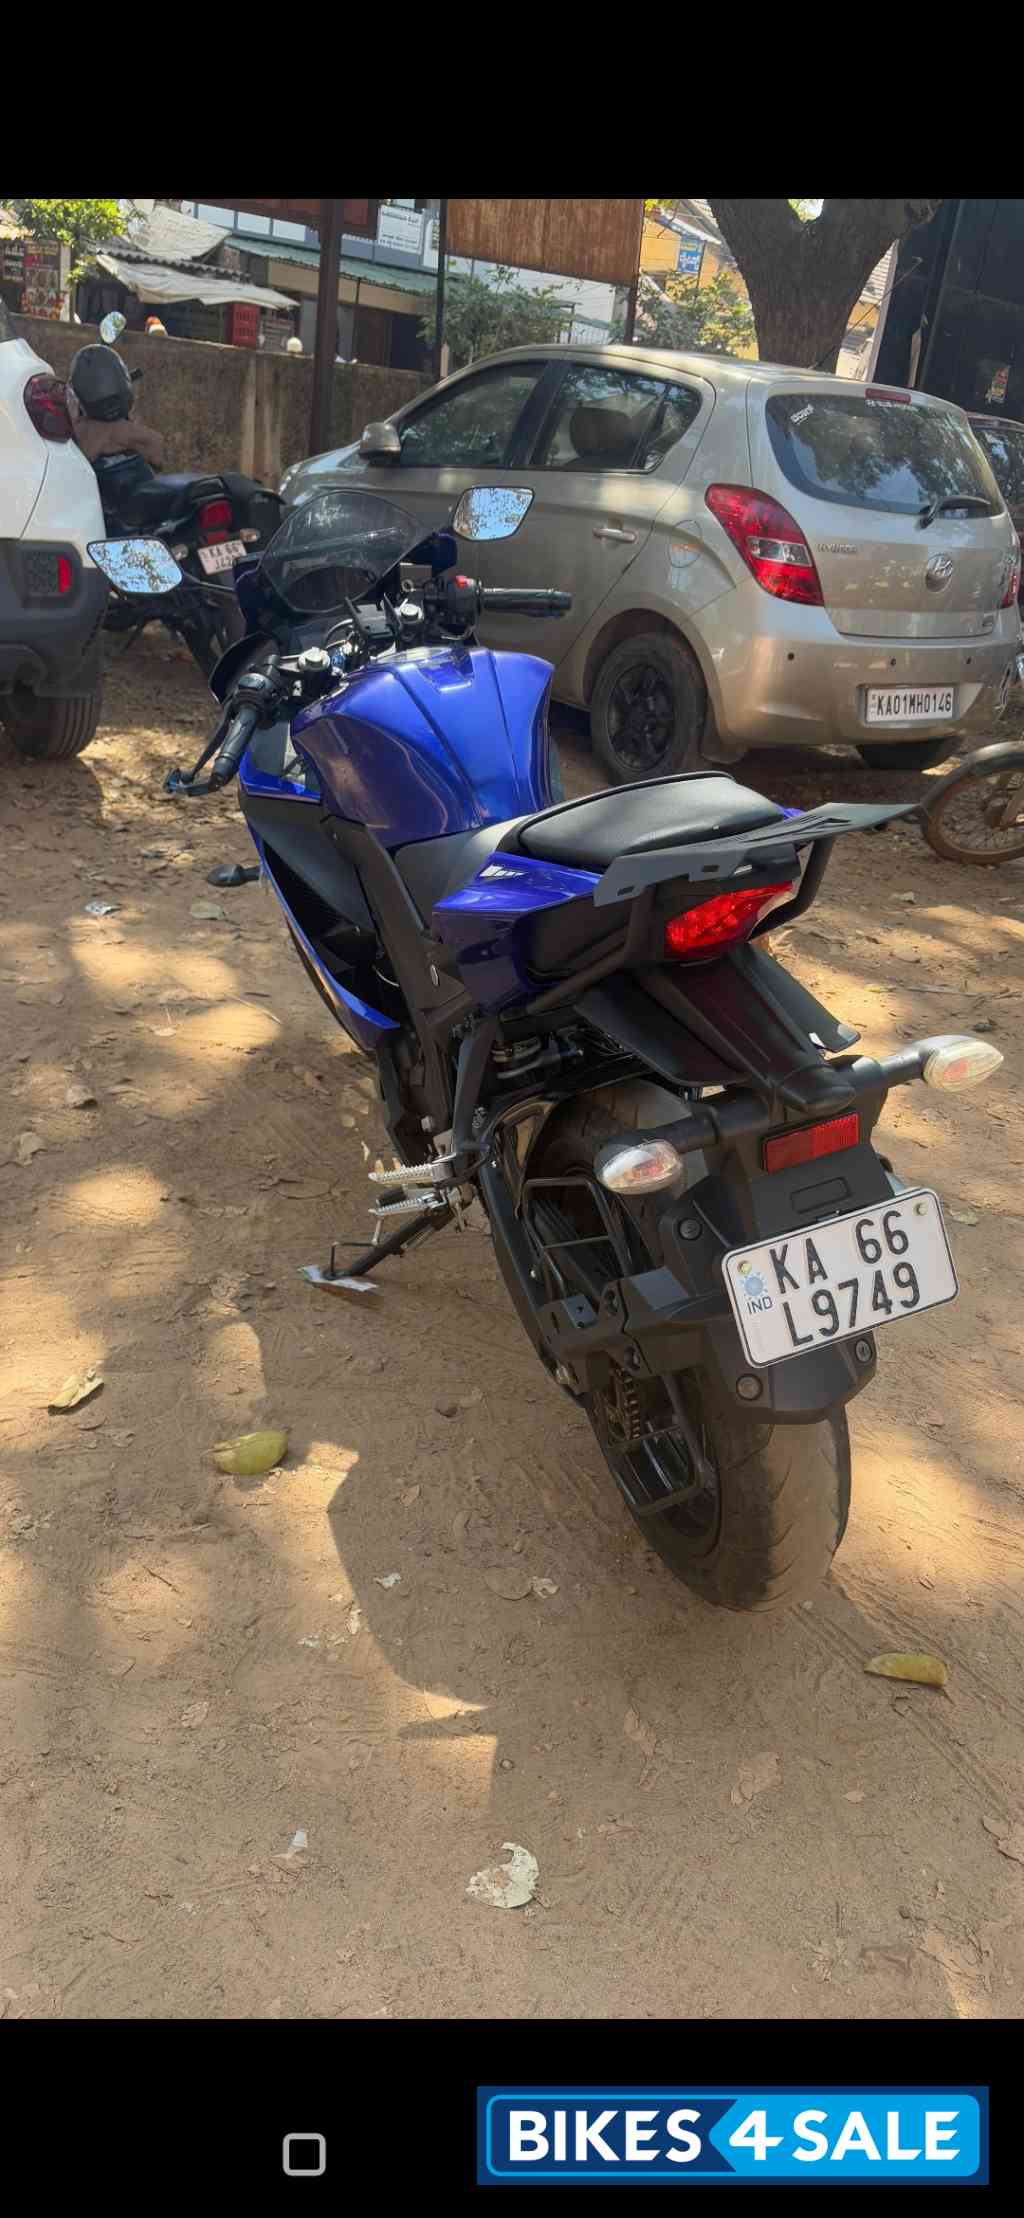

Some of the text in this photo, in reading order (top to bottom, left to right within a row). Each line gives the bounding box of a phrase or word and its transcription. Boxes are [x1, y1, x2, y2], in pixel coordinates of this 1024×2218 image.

[876, 692, 952, 716] KA01MH0146
[769, 1210, 909, 1295] KA 66
[746, 1296, 773, 1315] IND
[782, 1261, 921, 1348] L9749
